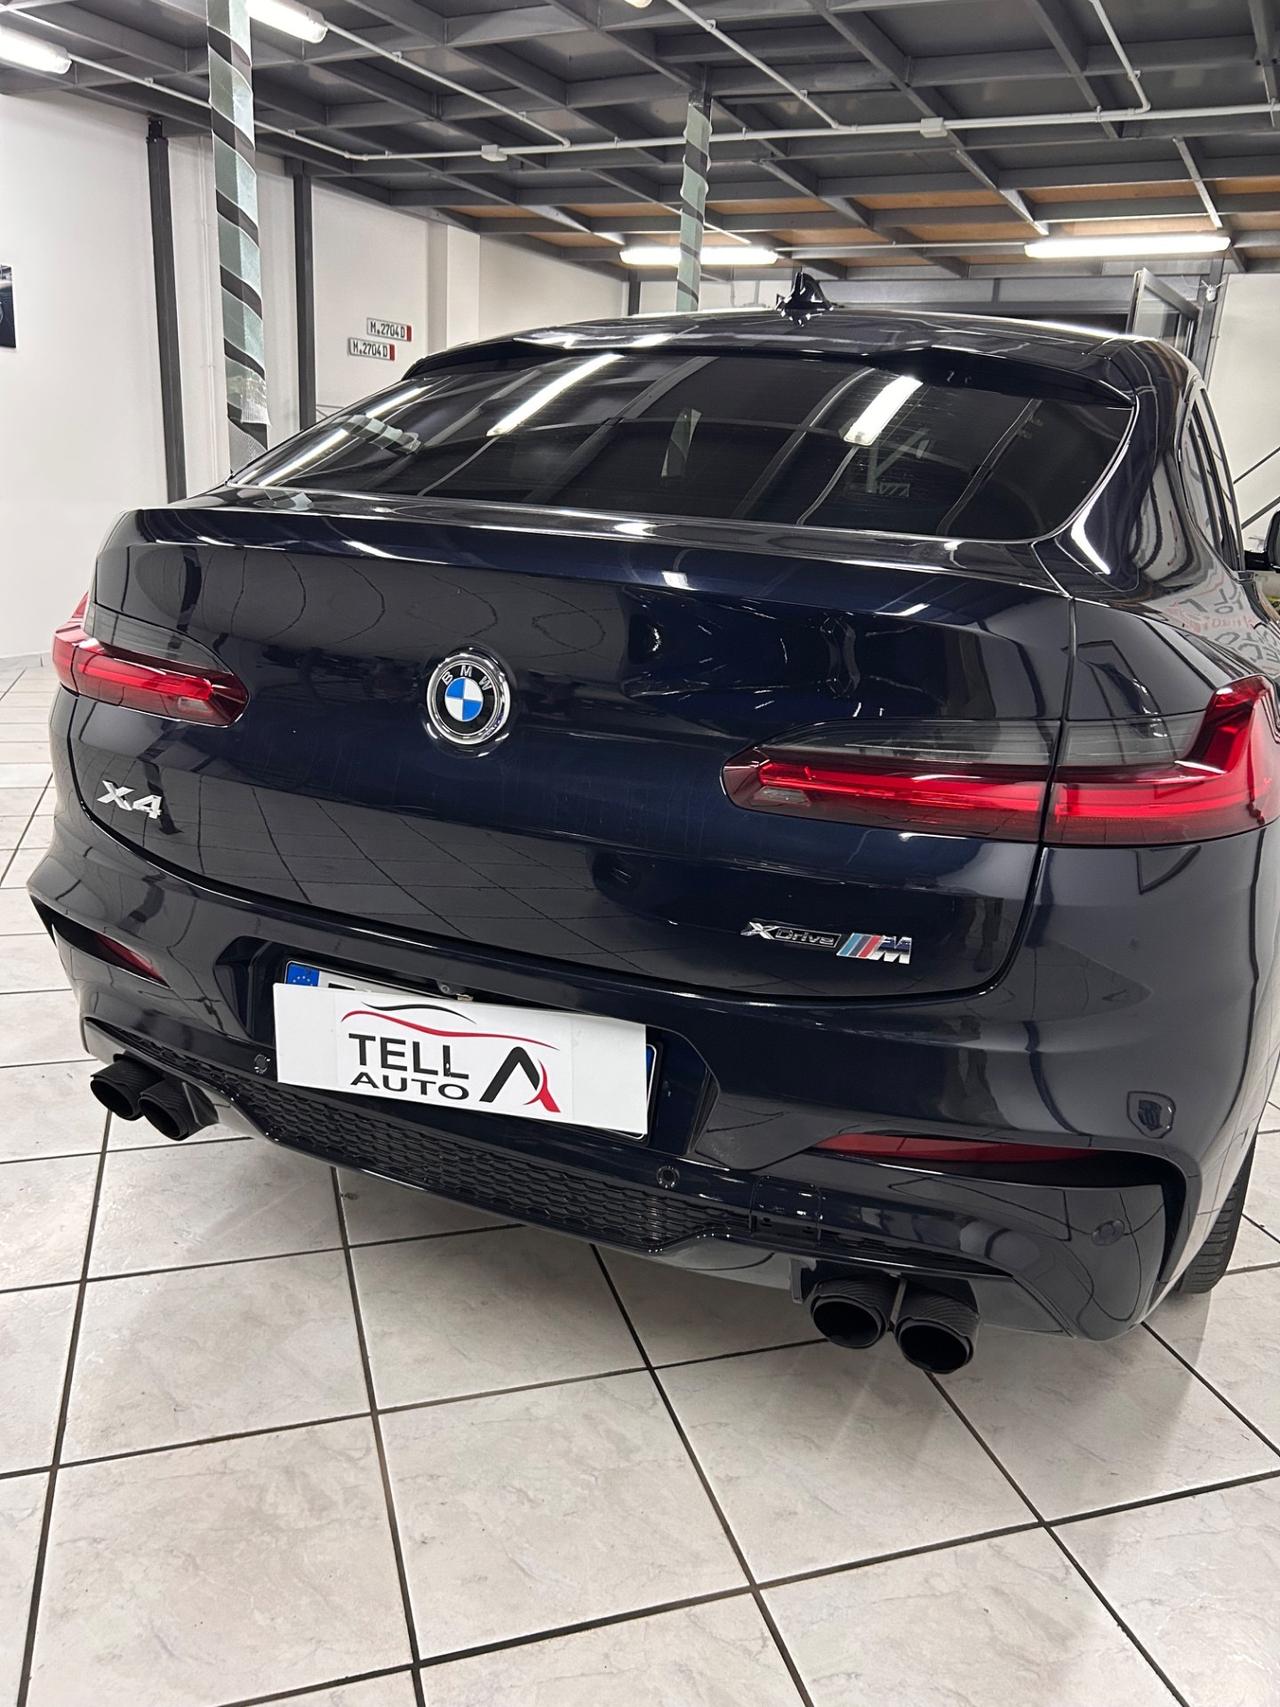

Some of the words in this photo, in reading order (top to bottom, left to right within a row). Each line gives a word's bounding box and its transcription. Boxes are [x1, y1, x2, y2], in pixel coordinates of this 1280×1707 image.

[441, 664, 493, 691] BMW
[97, 780, 162, 819] X4
[349, 1033, 469, 1080] TELL
[350, 1071, 470, 1100] AUTO
